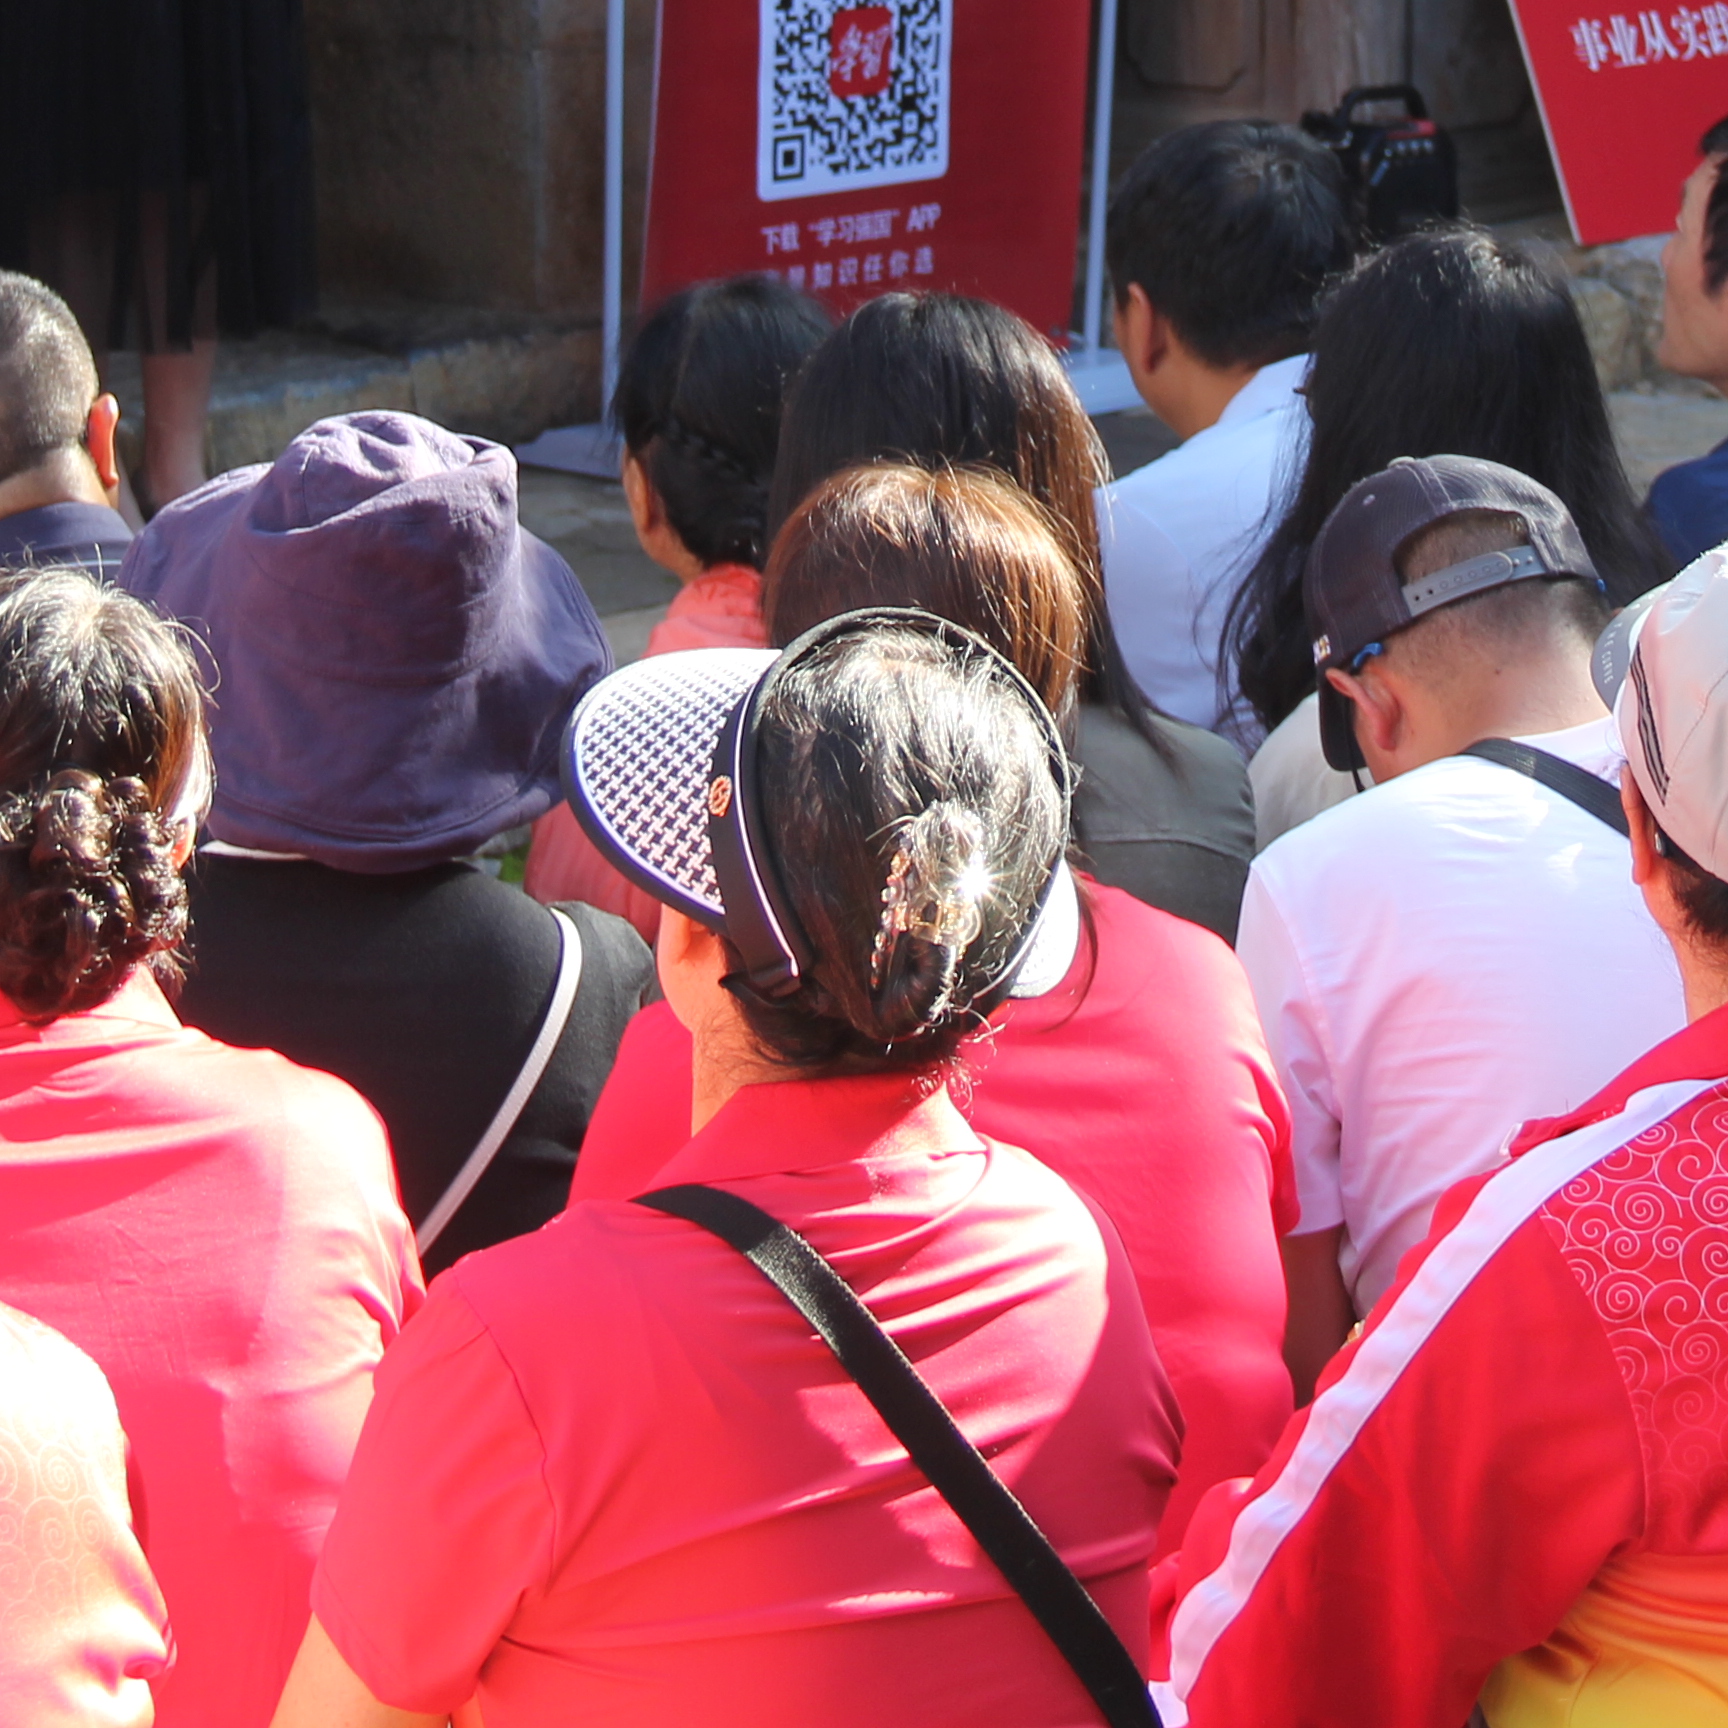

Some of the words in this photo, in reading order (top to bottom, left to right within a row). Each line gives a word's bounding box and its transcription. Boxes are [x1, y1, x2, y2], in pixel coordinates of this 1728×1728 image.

[762, 245, 934, 292] 量知识任你选
